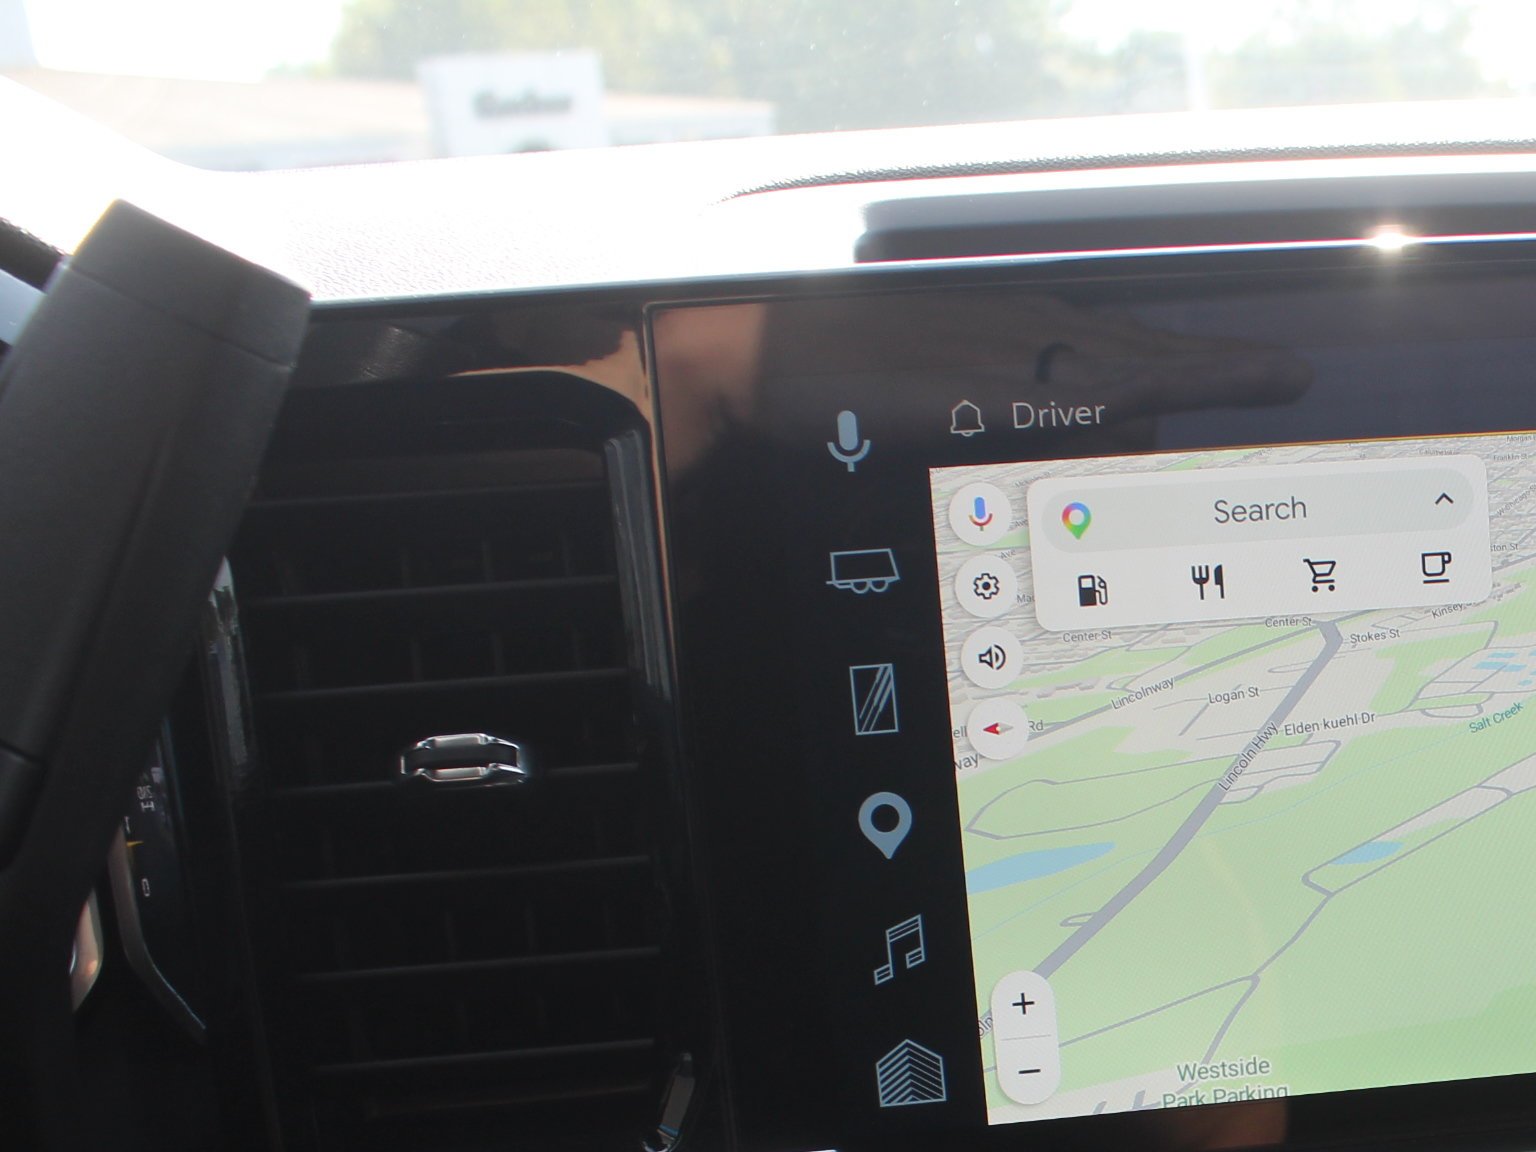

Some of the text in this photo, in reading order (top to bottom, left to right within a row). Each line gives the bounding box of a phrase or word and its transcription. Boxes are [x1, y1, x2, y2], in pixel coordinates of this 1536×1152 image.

[1011, 401, 1106, 431] Driver
[1506, 434, 1531, 444] Morgan
[1493, 453, 1518, 462] Franklin
[1212, 495, 1308, 525] Search
[1509, 543, 1519, 551] St
[1431, 602, 1464, 620] Kinsey
[1265, 615, 1313, 629] Center St
[1062, 630, 1112, 643] Center St
[1350, 628, 1400, 644] Stokes St
[1111, 677, 1175, 711] Lincolnway
[1208, 686, 1260, 705] Logan St
[1284, 711, 1376, 737] Elden kuehl Dr
[1468, 701, 1525, 734] Salt Creek
[1218, 722, 1279, 792] Lincoln Hwy
[1176, 1056, 1271, 1082] Westside
[1162, 1085, 1288, 1109] Park Parking
